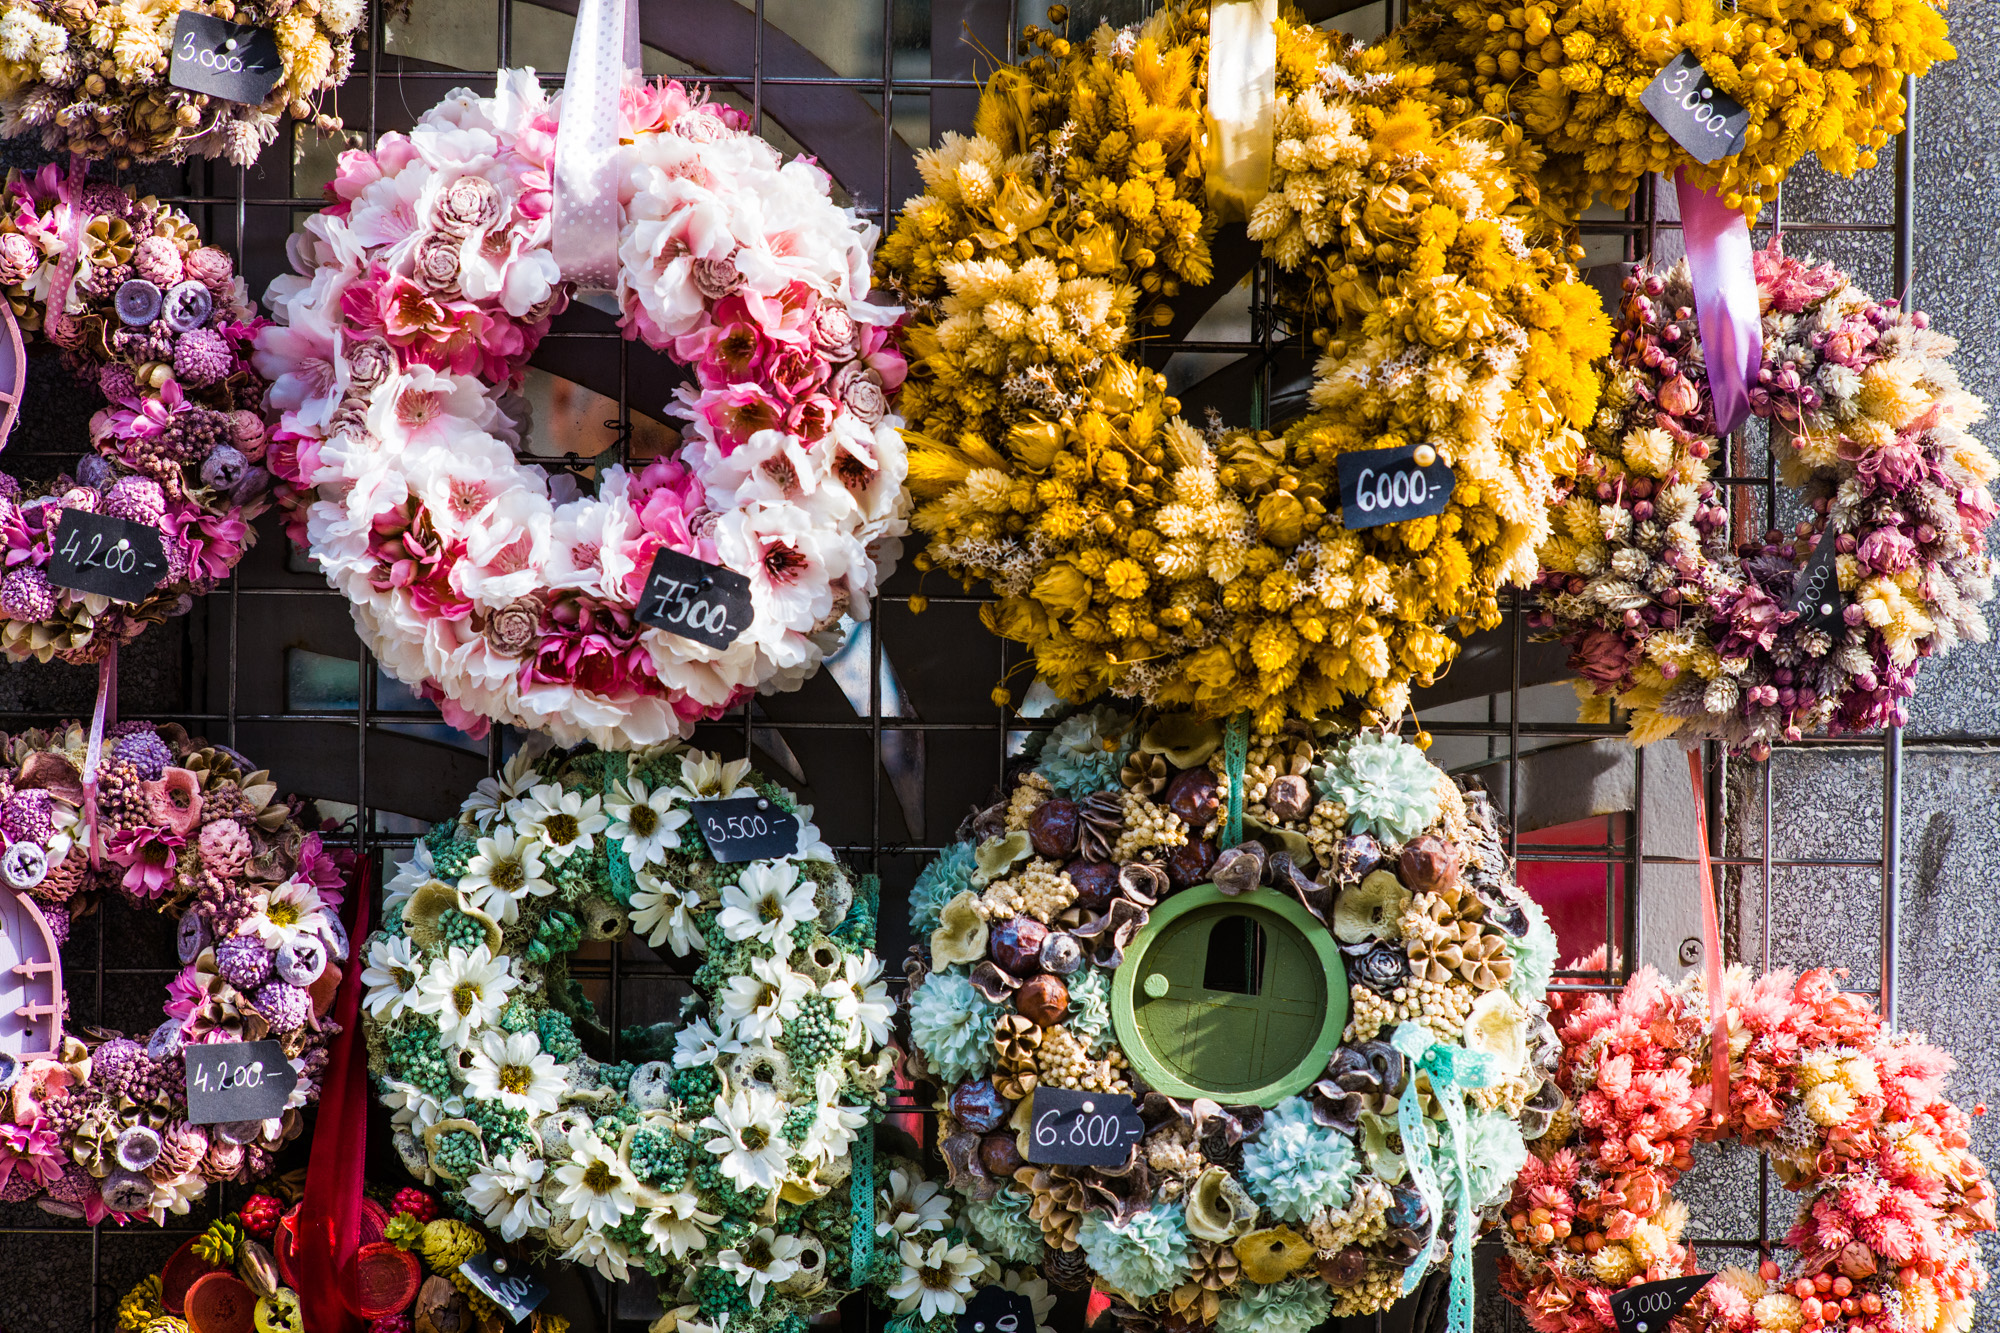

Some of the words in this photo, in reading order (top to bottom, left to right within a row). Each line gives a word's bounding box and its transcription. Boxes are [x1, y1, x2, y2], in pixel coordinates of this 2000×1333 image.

[177, 32, 264, 73] 3.000.-
[1663, 69, 1735, 138] 3.000.-
[1356, 468, 1441, 511] 6000.-
[60, 528, 156, 575] 4.200.-
[653, 574, 737, 636] 7500.-
[1797, 553, 1830, 621] 3.000.-
[707, 815, 787, 842] 3.500.-
[193, 1061, 283, 1092] 4.200.-
[1035, 1109, 1139, 1147] 6.800.-
[1622, 1286, 1687, 1323] 3.000.-
